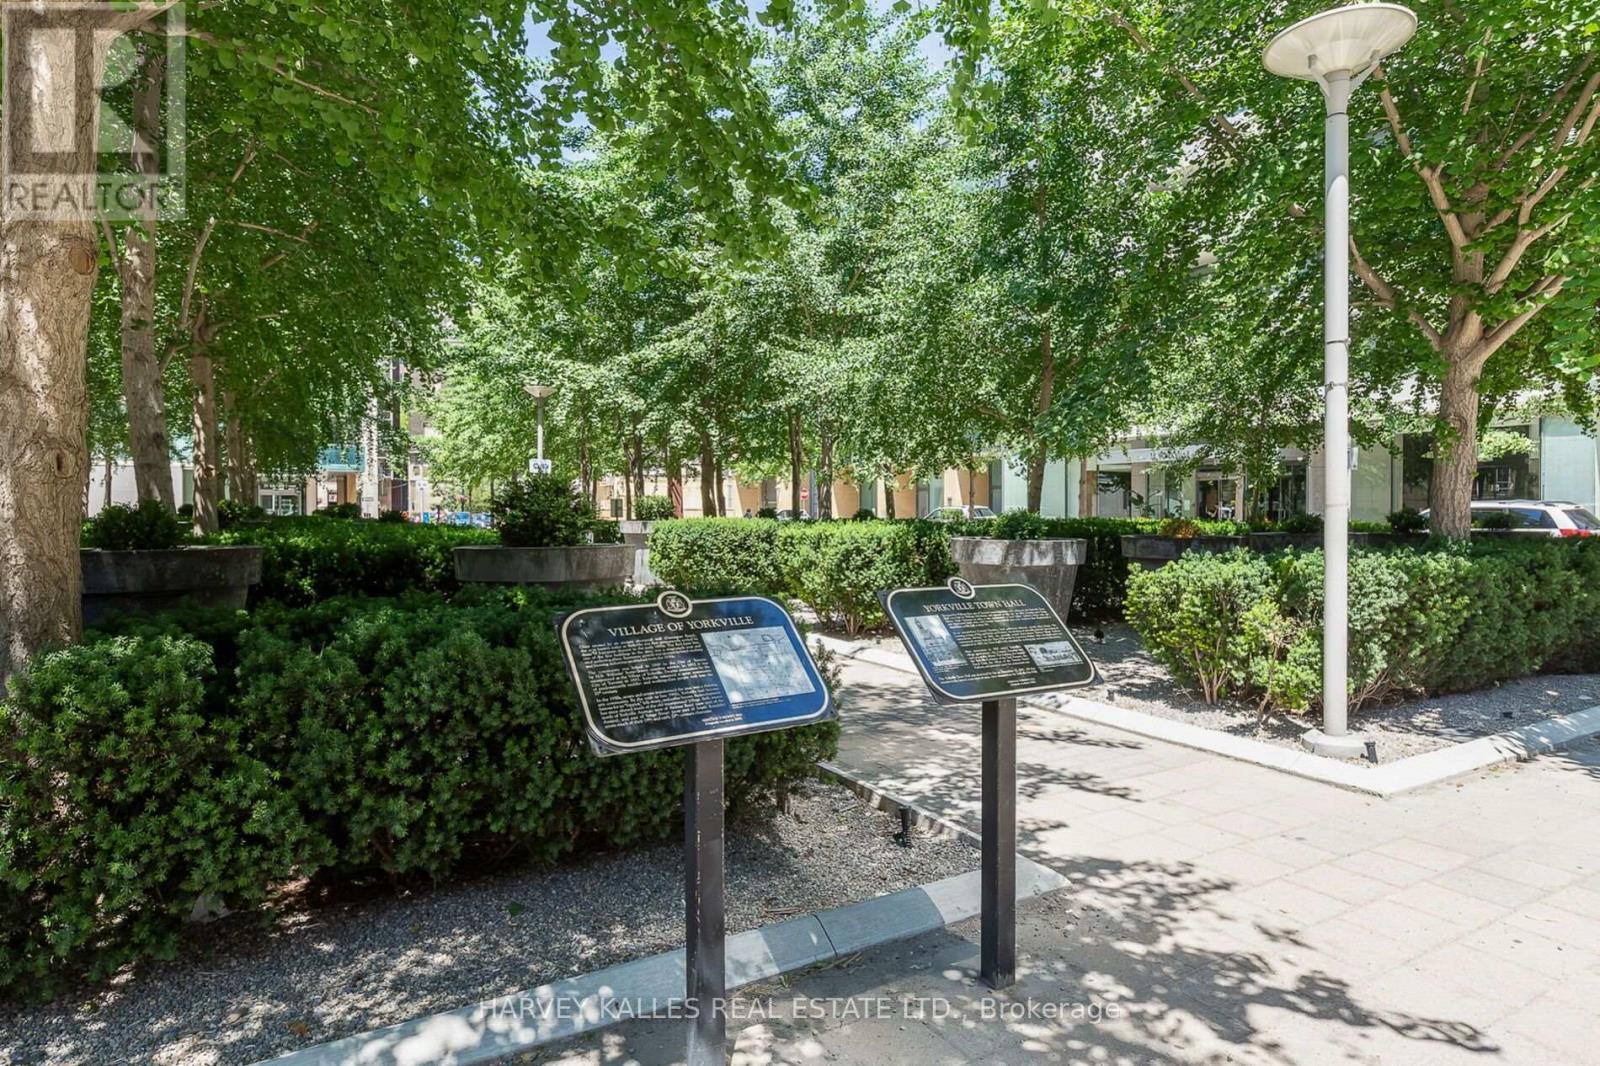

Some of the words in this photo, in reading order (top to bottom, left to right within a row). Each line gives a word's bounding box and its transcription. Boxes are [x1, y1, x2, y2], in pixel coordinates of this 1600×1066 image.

[923, 602, 975, 613] YORKVILLE
[974, 600, 1003, 610] TOWN
[1003, 599, 1026, 608] HALL
[608, 623, 665, 637] VILLAGE
[667, 621, 684, 632] OF
[686, 616, 754, 630] YORKVILLE
